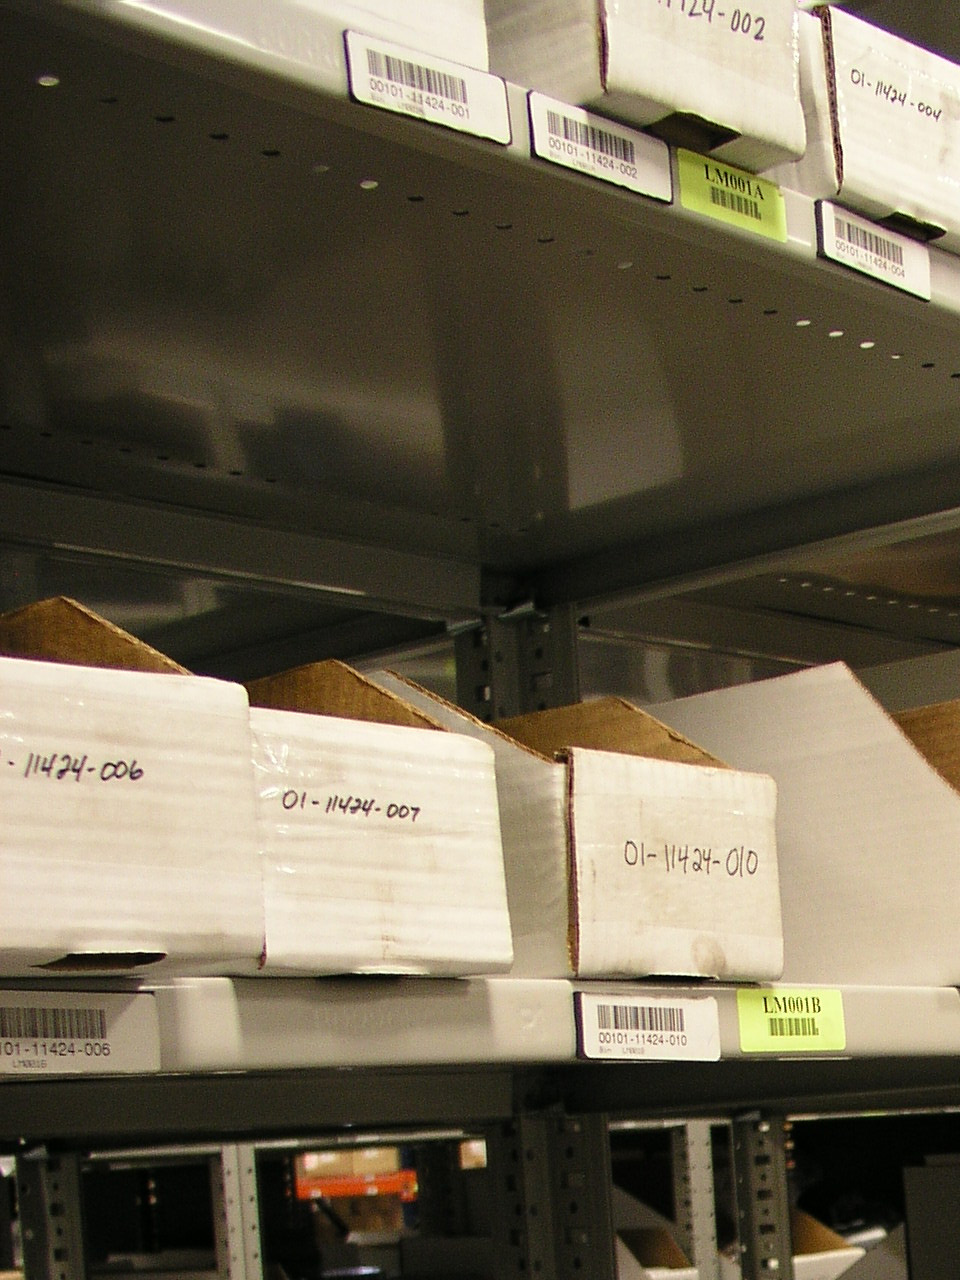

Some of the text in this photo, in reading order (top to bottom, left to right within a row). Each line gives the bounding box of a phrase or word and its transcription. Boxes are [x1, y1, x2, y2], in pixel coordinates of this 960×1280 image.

[850, 68, 943, 122] 01-11424-004
[704, 163, 765, 200] LM001A
[282, 790, 421, 822] 01-11424-007
[624, 840, 759, 878] 01-11424-010
[762, 995, 822, 1015] LM001B
[598, 1031, 688, 1047] 00101-11424-010
